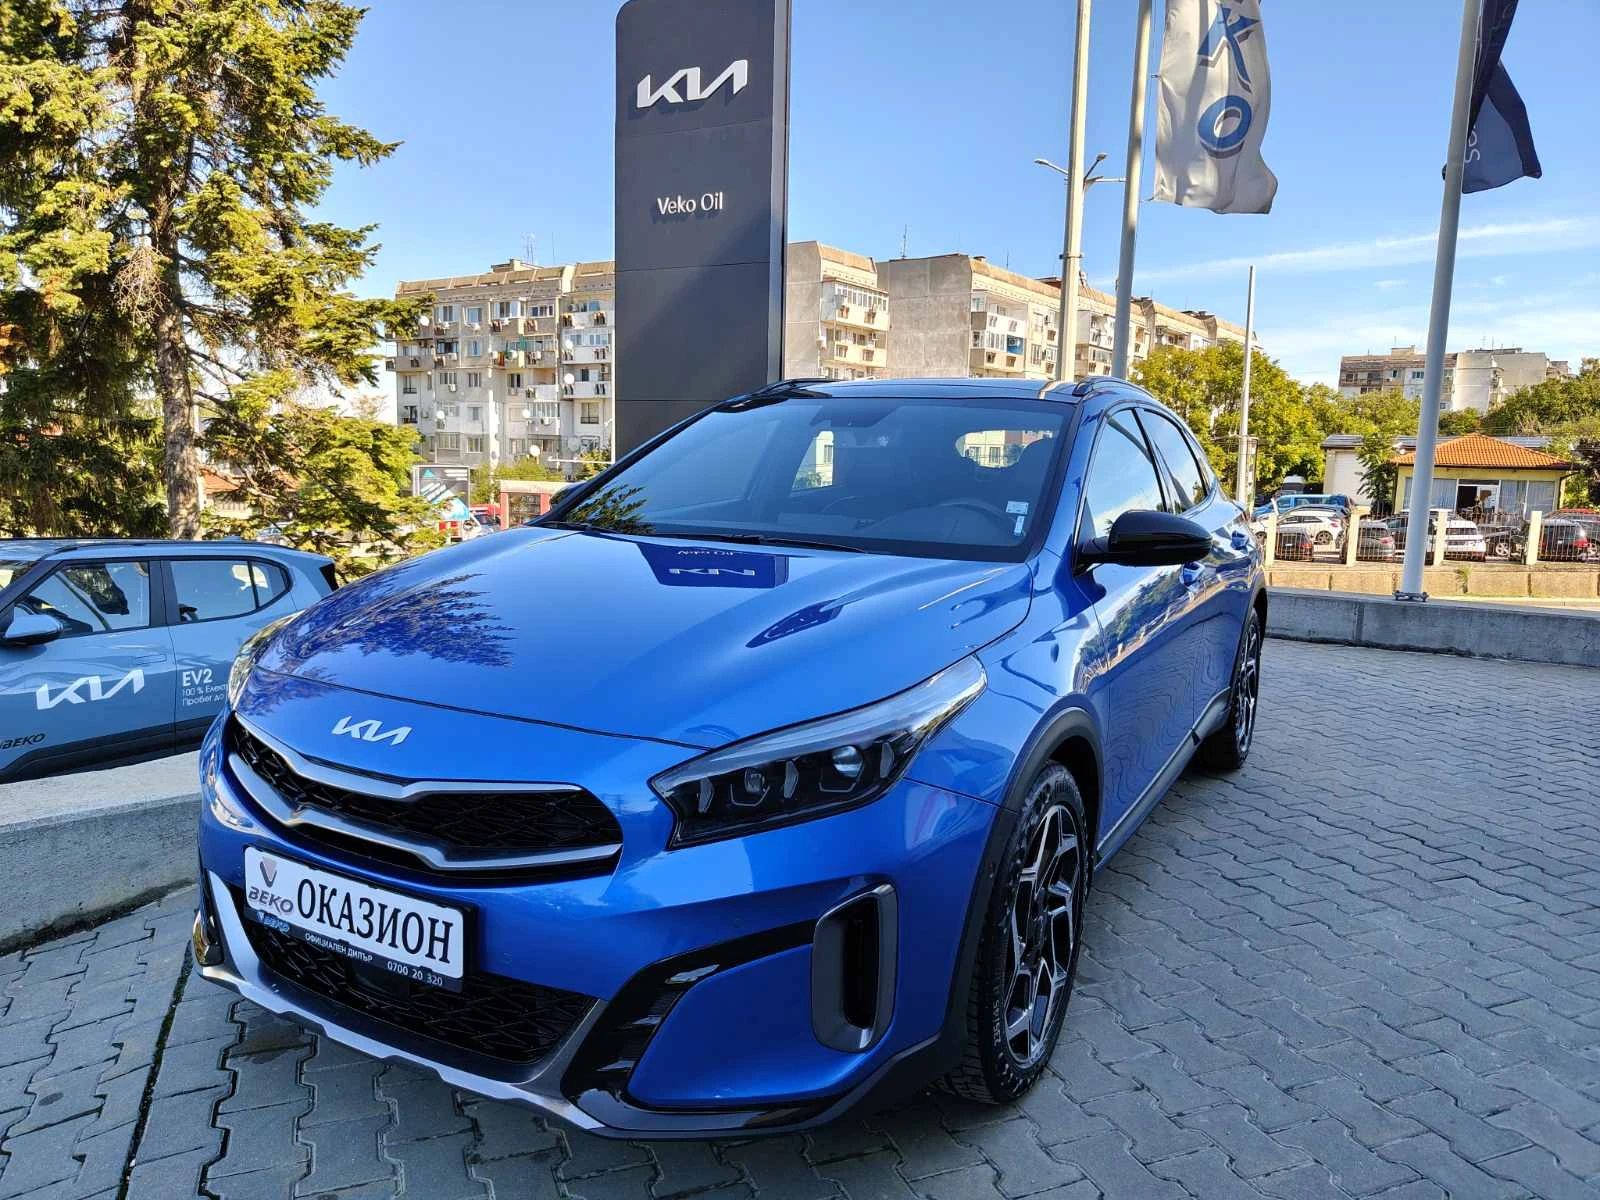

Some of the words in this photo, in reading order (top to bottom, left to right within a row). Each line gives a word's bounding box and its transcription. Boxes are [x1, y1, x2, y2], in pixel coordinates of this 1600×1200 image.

[636, 59, 749, 109] KIA
[656, 195, 697, 215] Veko
[700, 191, 724, 211] Oil
[35, 668, 146, 711] KIA
[182, 668, 213, 687] EV2
[182, 687, 196, 697] 100
[197, 687, 204, 695] %
[331, 715, 413, 746] KIA
[249, 886, 294, 914] ВЕКО
[297, 878, 454, 964] ОКАЗИОН
[304, 932, 347, 955] ОФИЦИАЛЕН
[347, 948, 373, 963] ДИЛЪР
[387, 960, 409, 976] 0700
[411, 968, 423, 981] 20
[426, 973, 443, 987] 320
